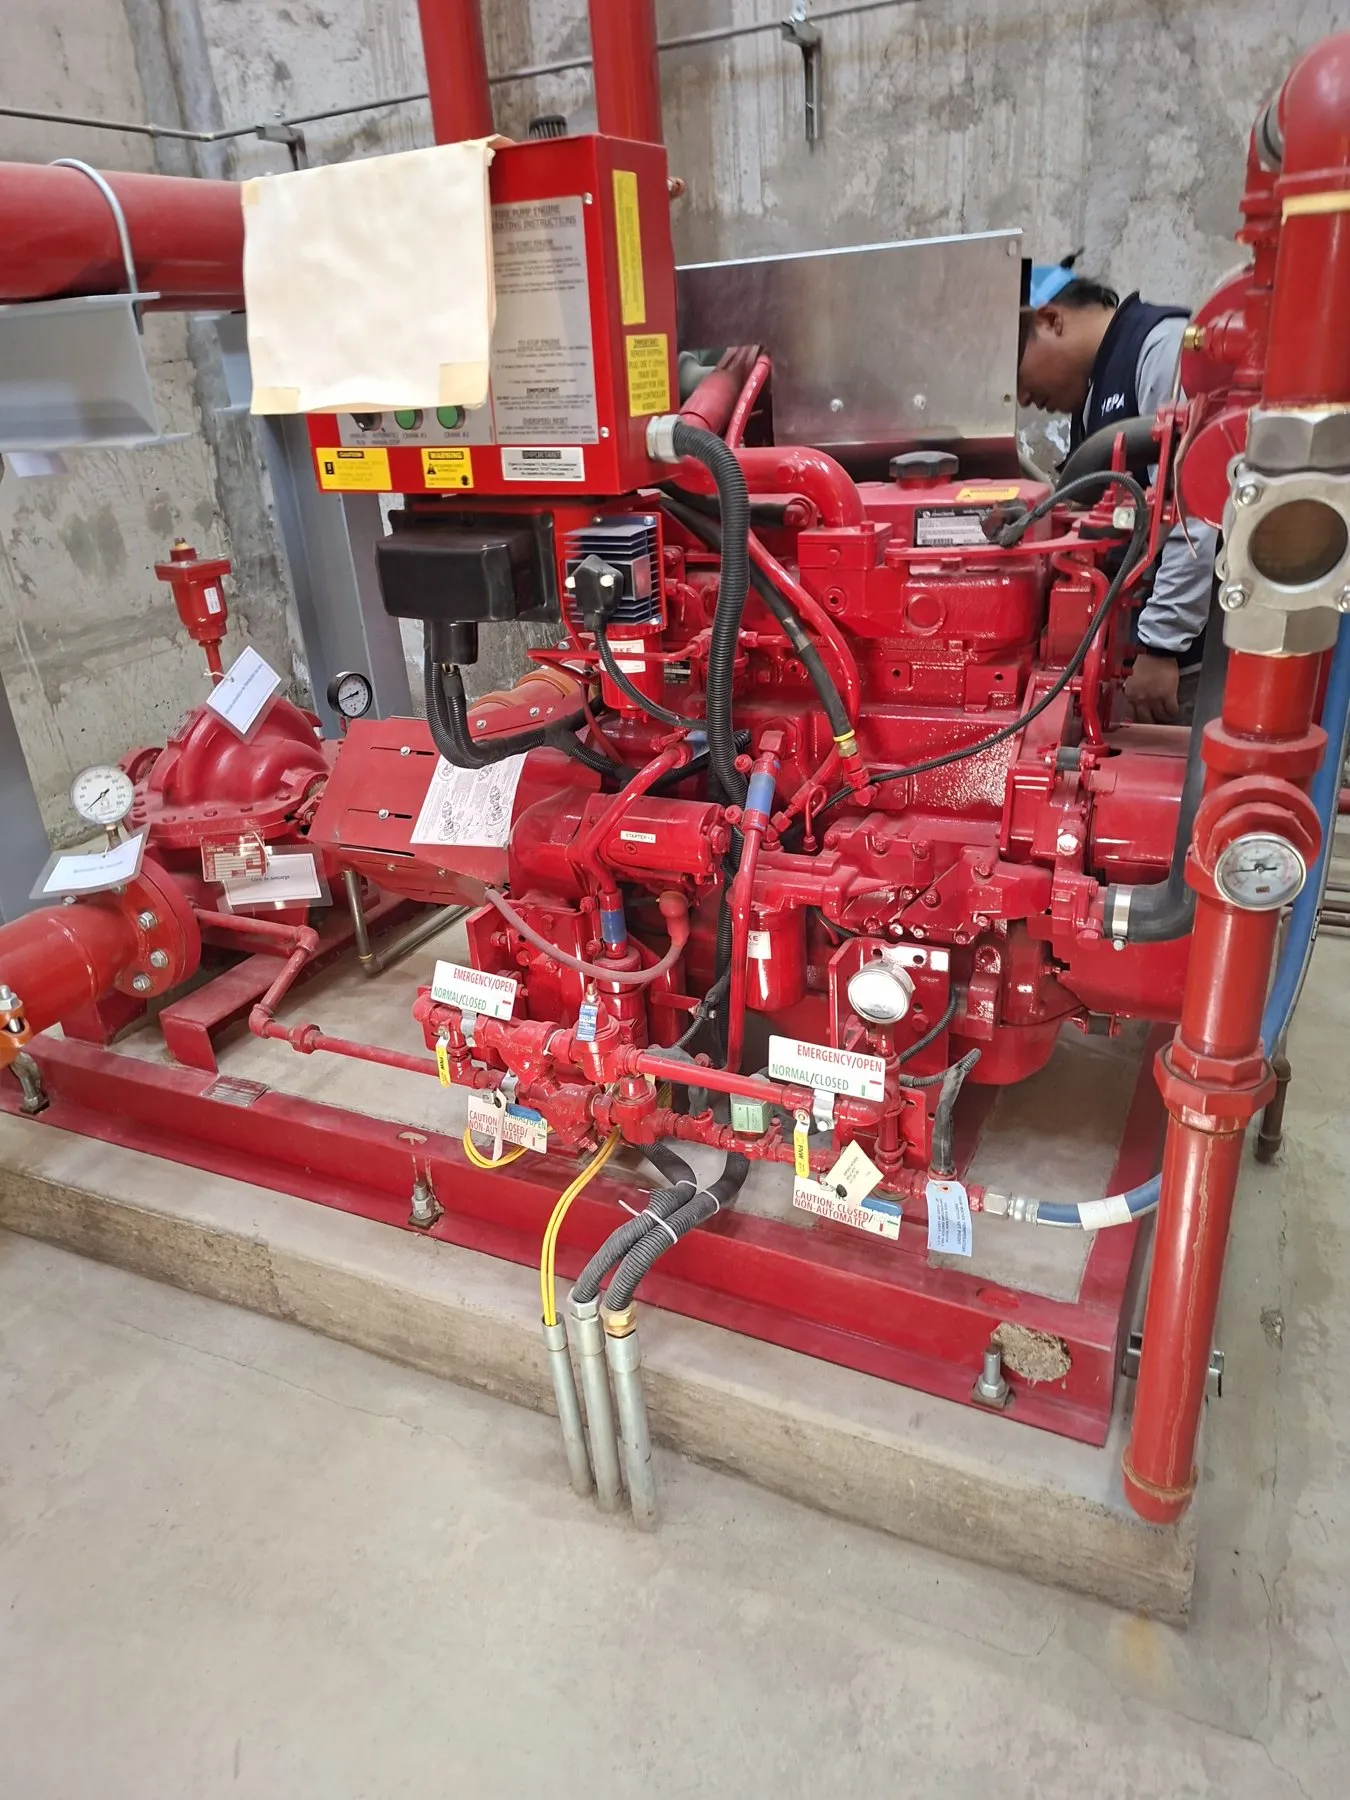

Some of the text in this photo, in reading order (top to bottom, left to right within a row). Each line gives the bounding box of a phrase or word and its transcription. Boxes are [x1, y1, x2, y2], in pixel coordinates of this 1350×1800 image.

[512, 207, 532, 217] PUMP
[533, 205, 560, 216] ENGINE
[523, 215, 577, 229] INSTRUCTIONS
[453, 967, 515, 994] EMERGENCY/OPEN
[433, 986, 487, 1011] NORMAL/CLOSED
[797, 1044, 882, 1073] EMERGENCY/OPEN
[772, 1063, 849, 1092] NORMAL/CLOSED
[469, 1110, 498, 1126] CAUTION
[795, 1189, 835, 1208] CAUTION:
[794, 1197, 867, 1229] NON-AUTOMATIC
